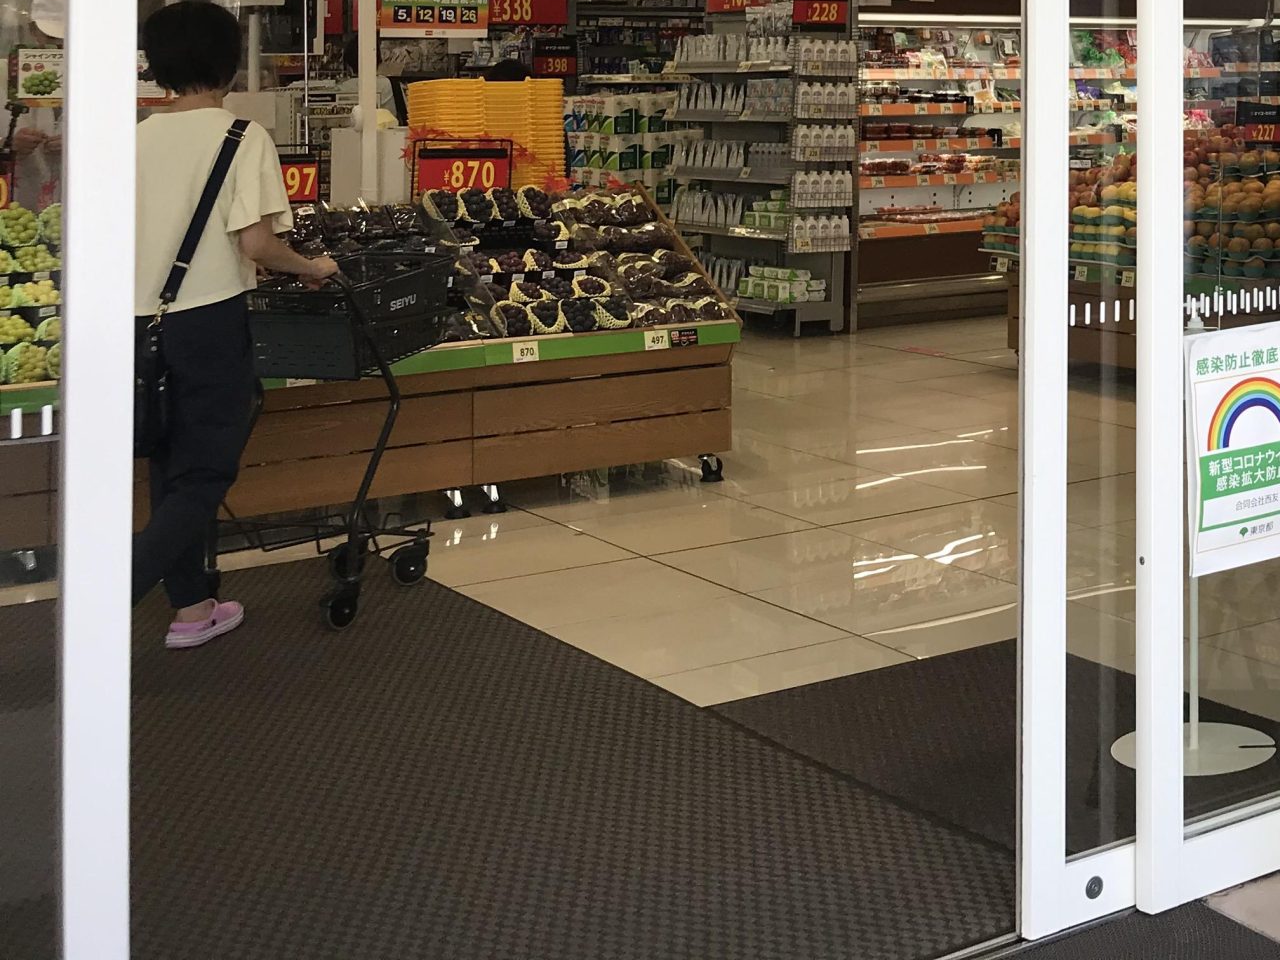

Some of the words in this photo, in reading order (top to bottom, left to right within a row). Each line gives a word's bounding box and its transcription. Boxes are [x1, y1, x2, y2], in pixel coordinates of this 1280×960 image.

[418, 9, 432, 20] 12
[441, 9, 455, 20] 19
[390, 293, 417, 311] SEIYU
[650, 335, 664, 345] 497
[519, 346, 535, 357] 870
[1235, 493, 1279, 511] 合同会社西友
[1250, 521, 1274, 537] 東京都
